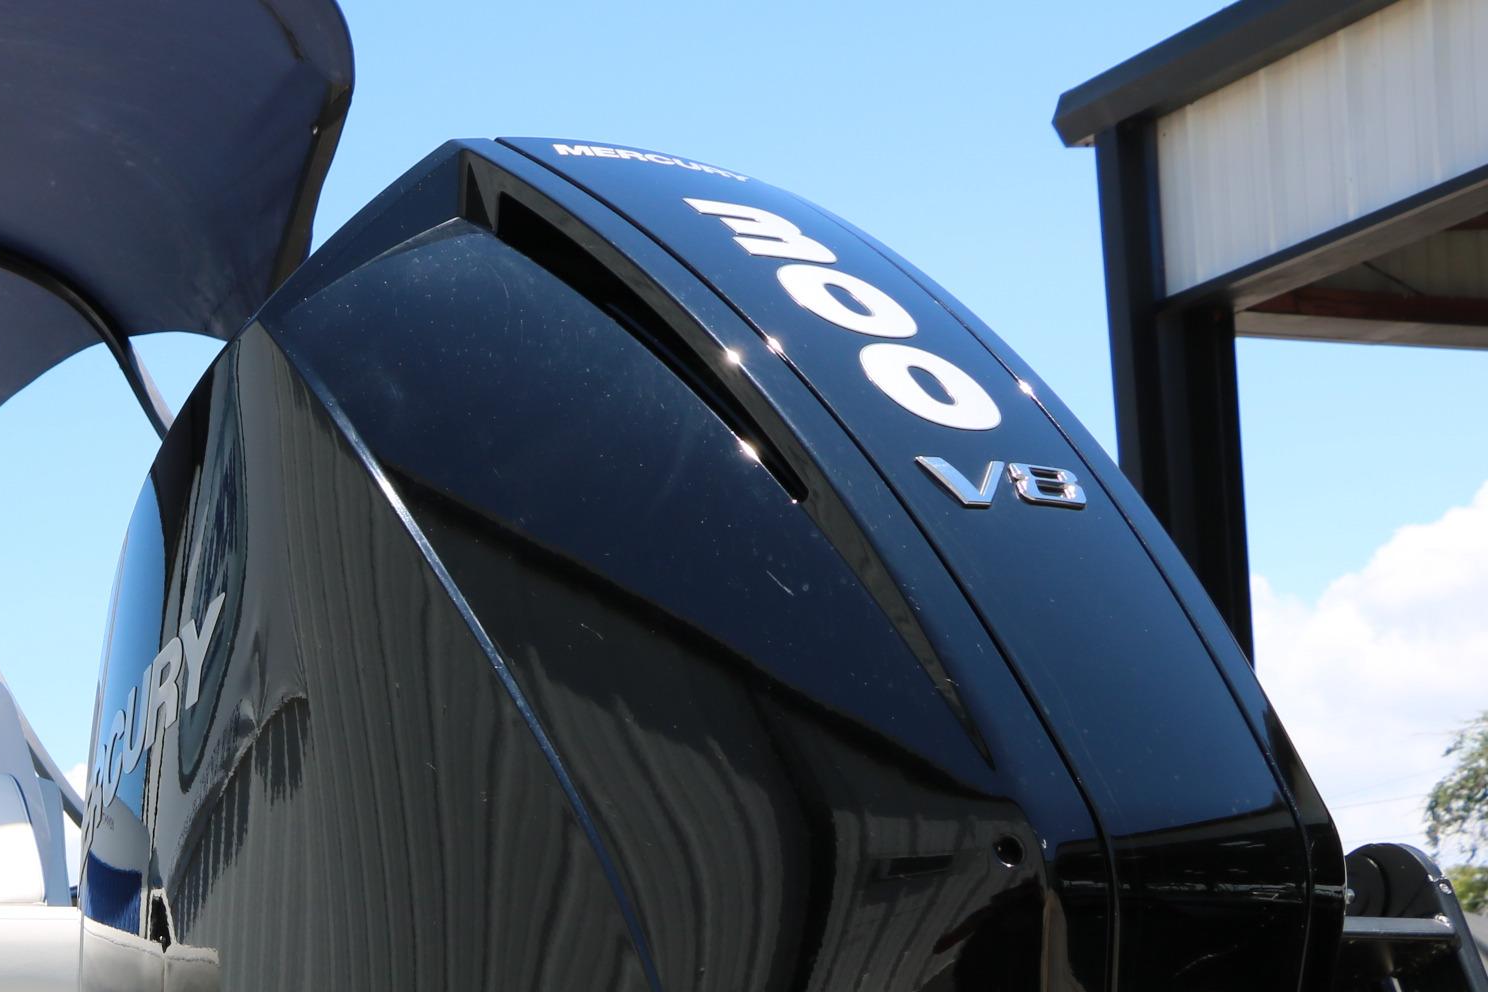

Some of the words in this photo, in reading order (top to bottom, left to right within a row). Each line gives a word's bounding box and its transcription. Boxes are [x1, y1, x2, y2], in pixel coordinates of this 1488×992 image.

[552, 143, 748, 182] MERCURY
[682, 197, 1001, 431] 300
[915, 455, 1087, 509] V8
